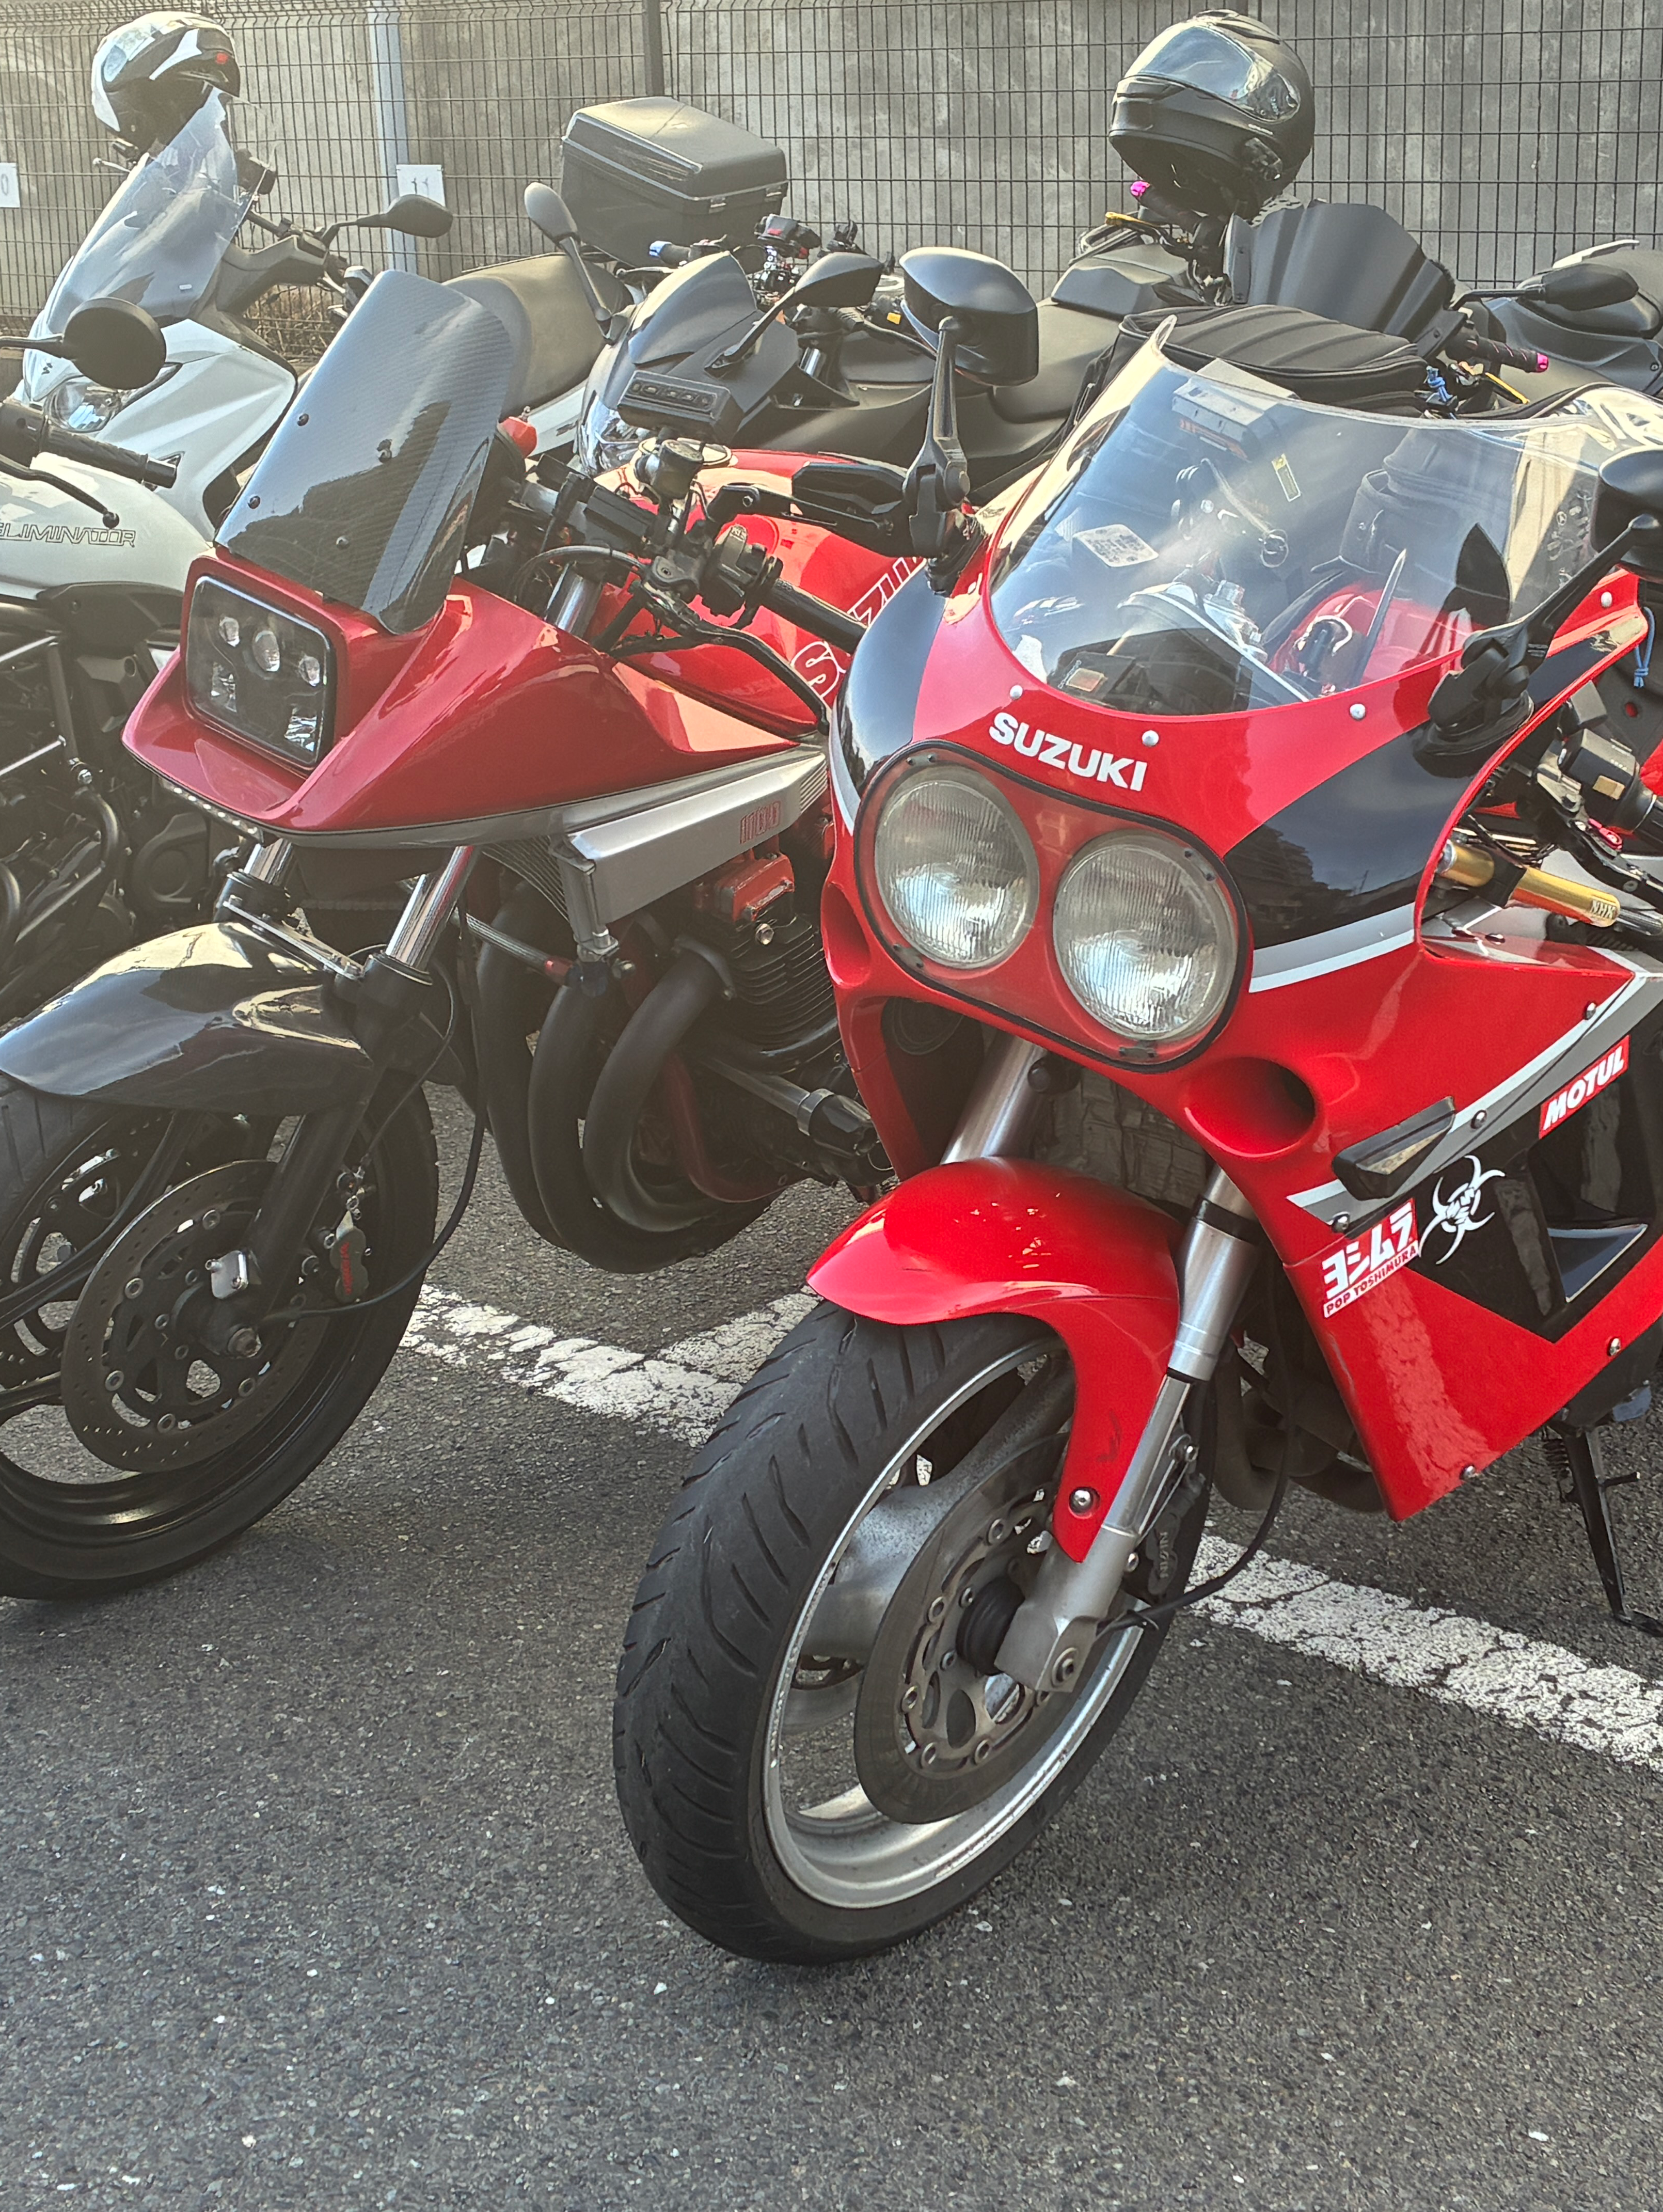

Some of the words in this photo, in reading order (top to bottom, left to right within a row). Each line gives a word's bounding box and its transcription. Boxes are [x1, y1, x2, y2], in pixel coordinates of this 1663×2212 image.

[989, 712, 1148, 792] SUZUKI
[1590, 899, 1616, 919] NHK
[1543, 1045, 1625, 1131] MOTUL
[1322, 1202, 1413, 1300] ヨシムラ
[1326, 1292, 1351, 1315] POP
[1354, 1245, 1417, 1296] YOSHIMURA
